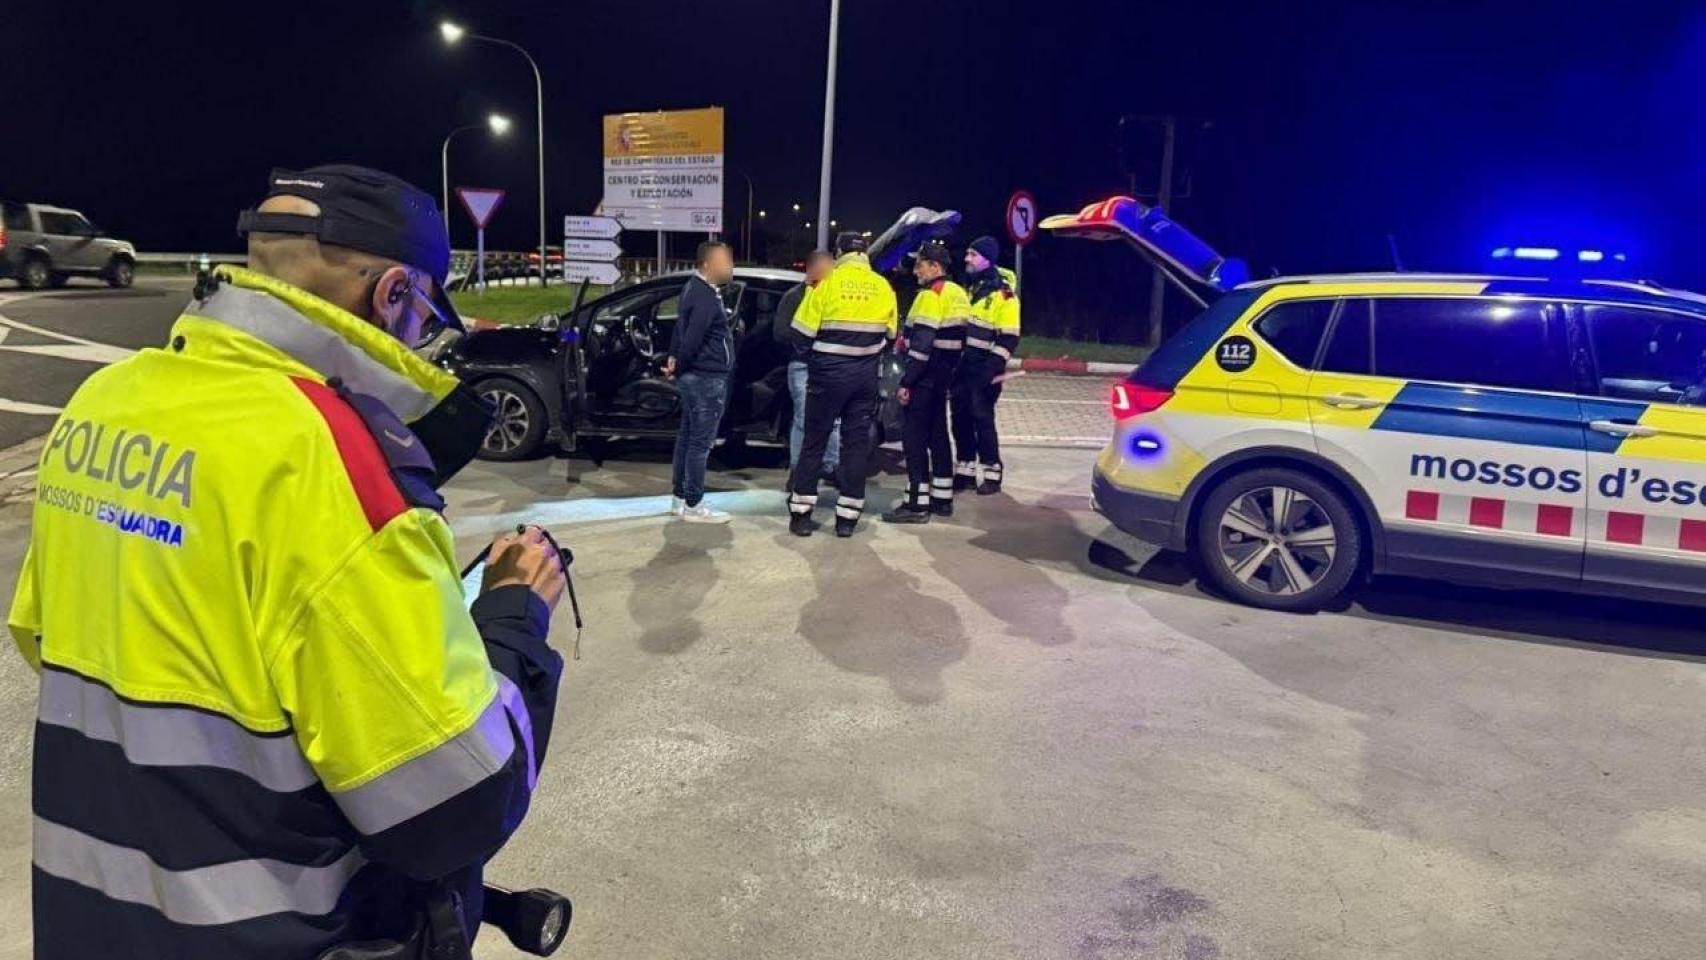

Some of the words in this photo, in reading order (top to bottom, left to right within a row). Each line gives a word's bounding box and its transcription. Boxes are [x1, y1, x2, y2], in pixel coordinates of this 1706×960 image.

[687, 155, 715, 164] ESTADO
[607, 175, 639, 185] CENTRO
[652, 173, 719, 185] CONSERVACIÓN
[1221, 344, 1251, 359] 112
[44, 418, 197, 509] POLICIA
[1409, 452, 1582, 493] mossos
[1598, 467, 1706, 507] d’es
